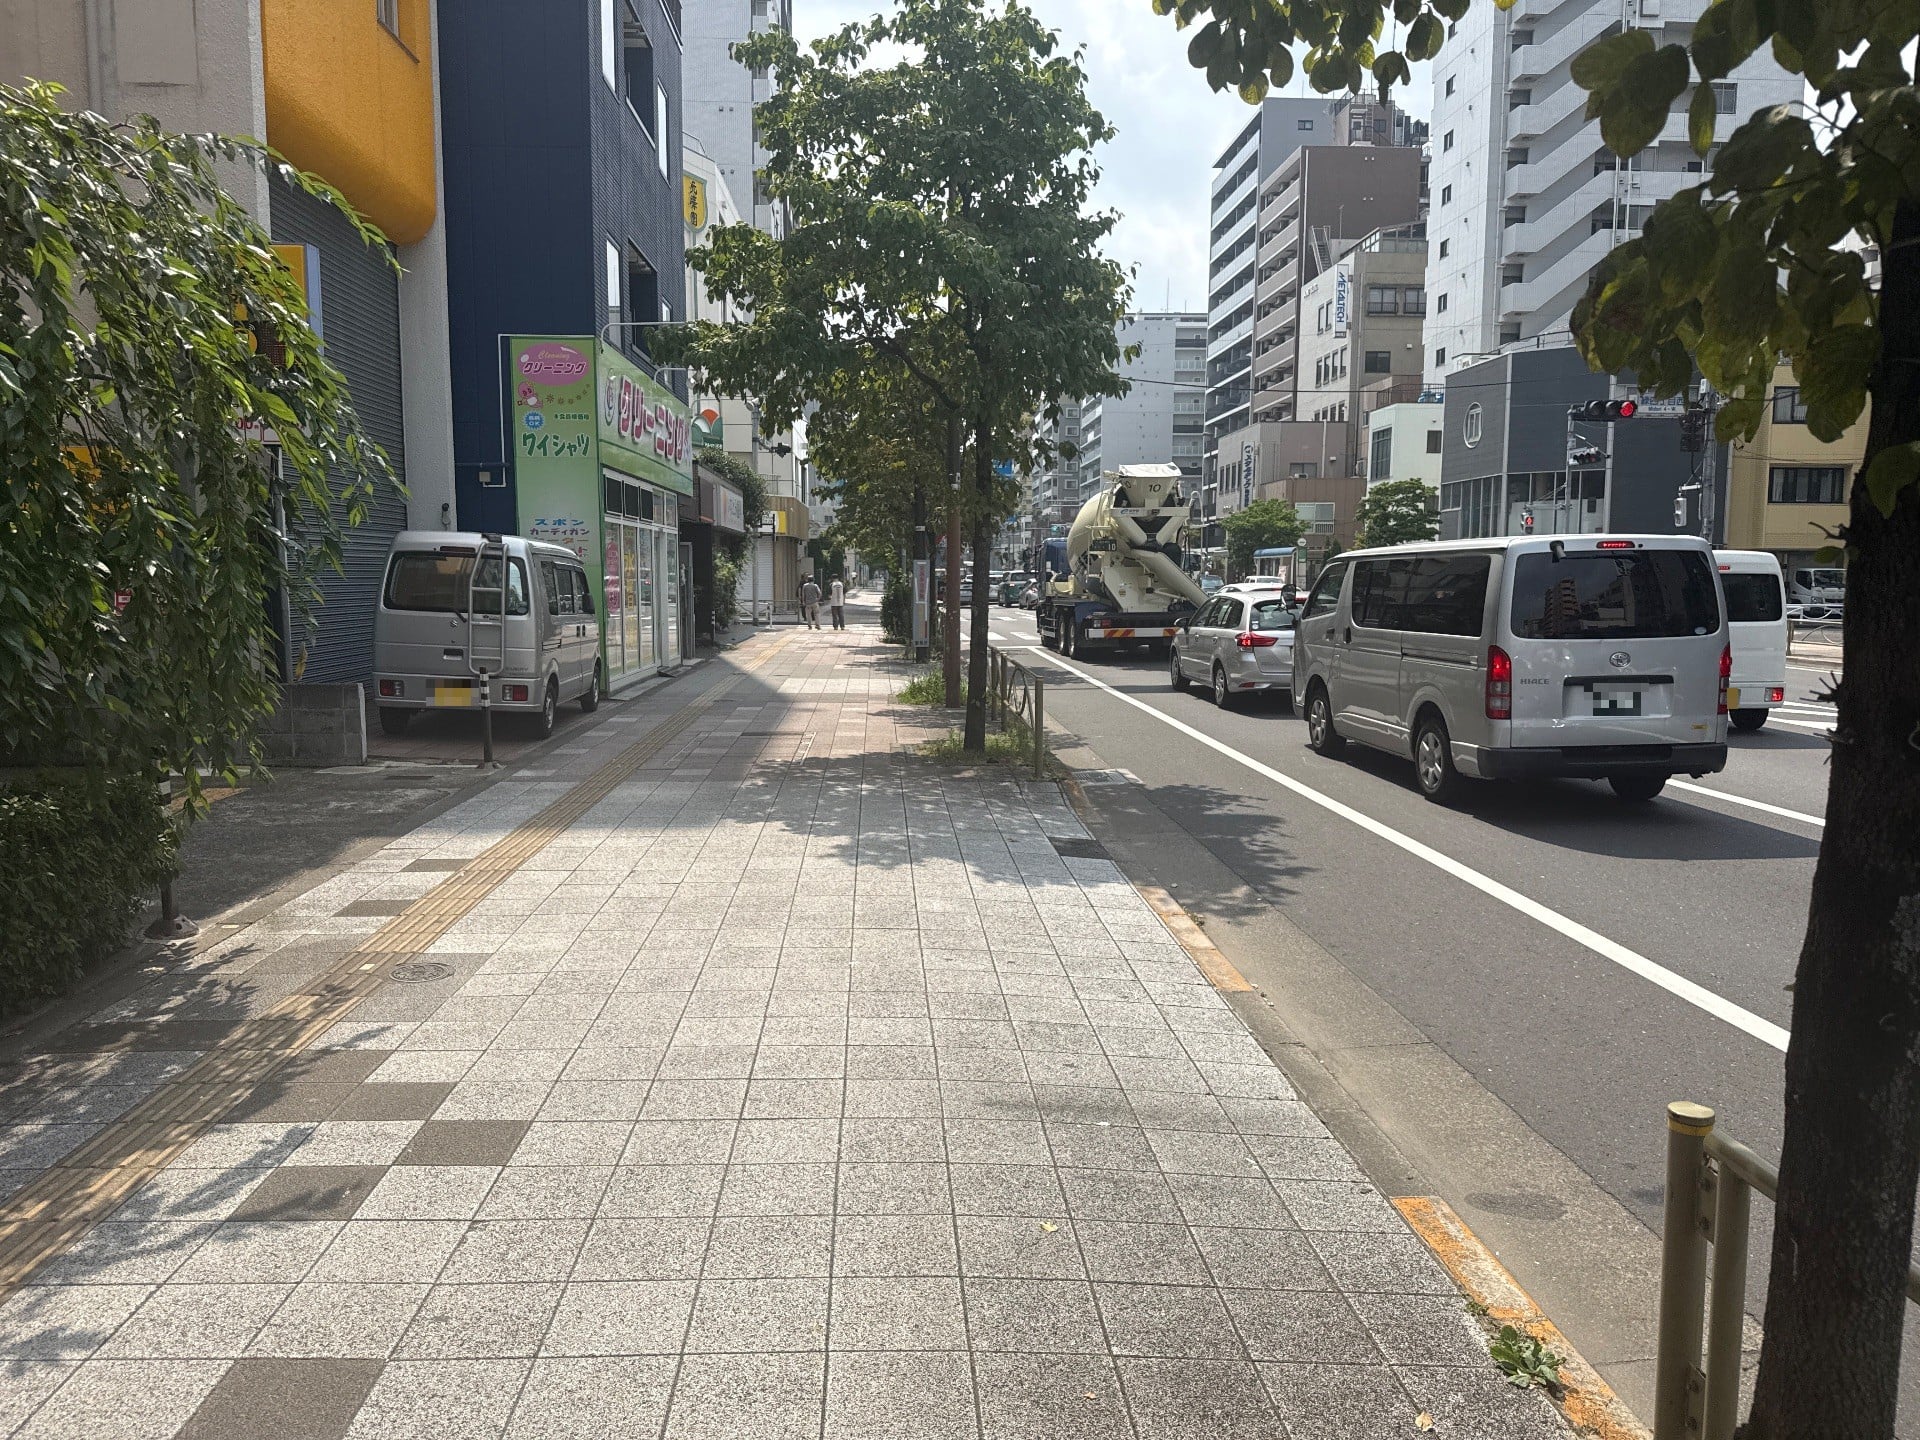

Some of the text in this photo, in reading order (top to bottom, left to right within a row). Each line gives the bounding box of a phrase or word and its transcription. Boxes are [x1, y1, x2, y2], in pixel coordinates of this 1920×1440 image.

[1337, 271, 1348, 323] METALTECH
[523, 362, 587, 374] クリーニング
[617, 375, 685, 465] クリーニング
[522, 433, 590, 456] ワイシャツ
[1148, 484, 1161, 492] 10
[530, 527, 590, 536] カーディガン
